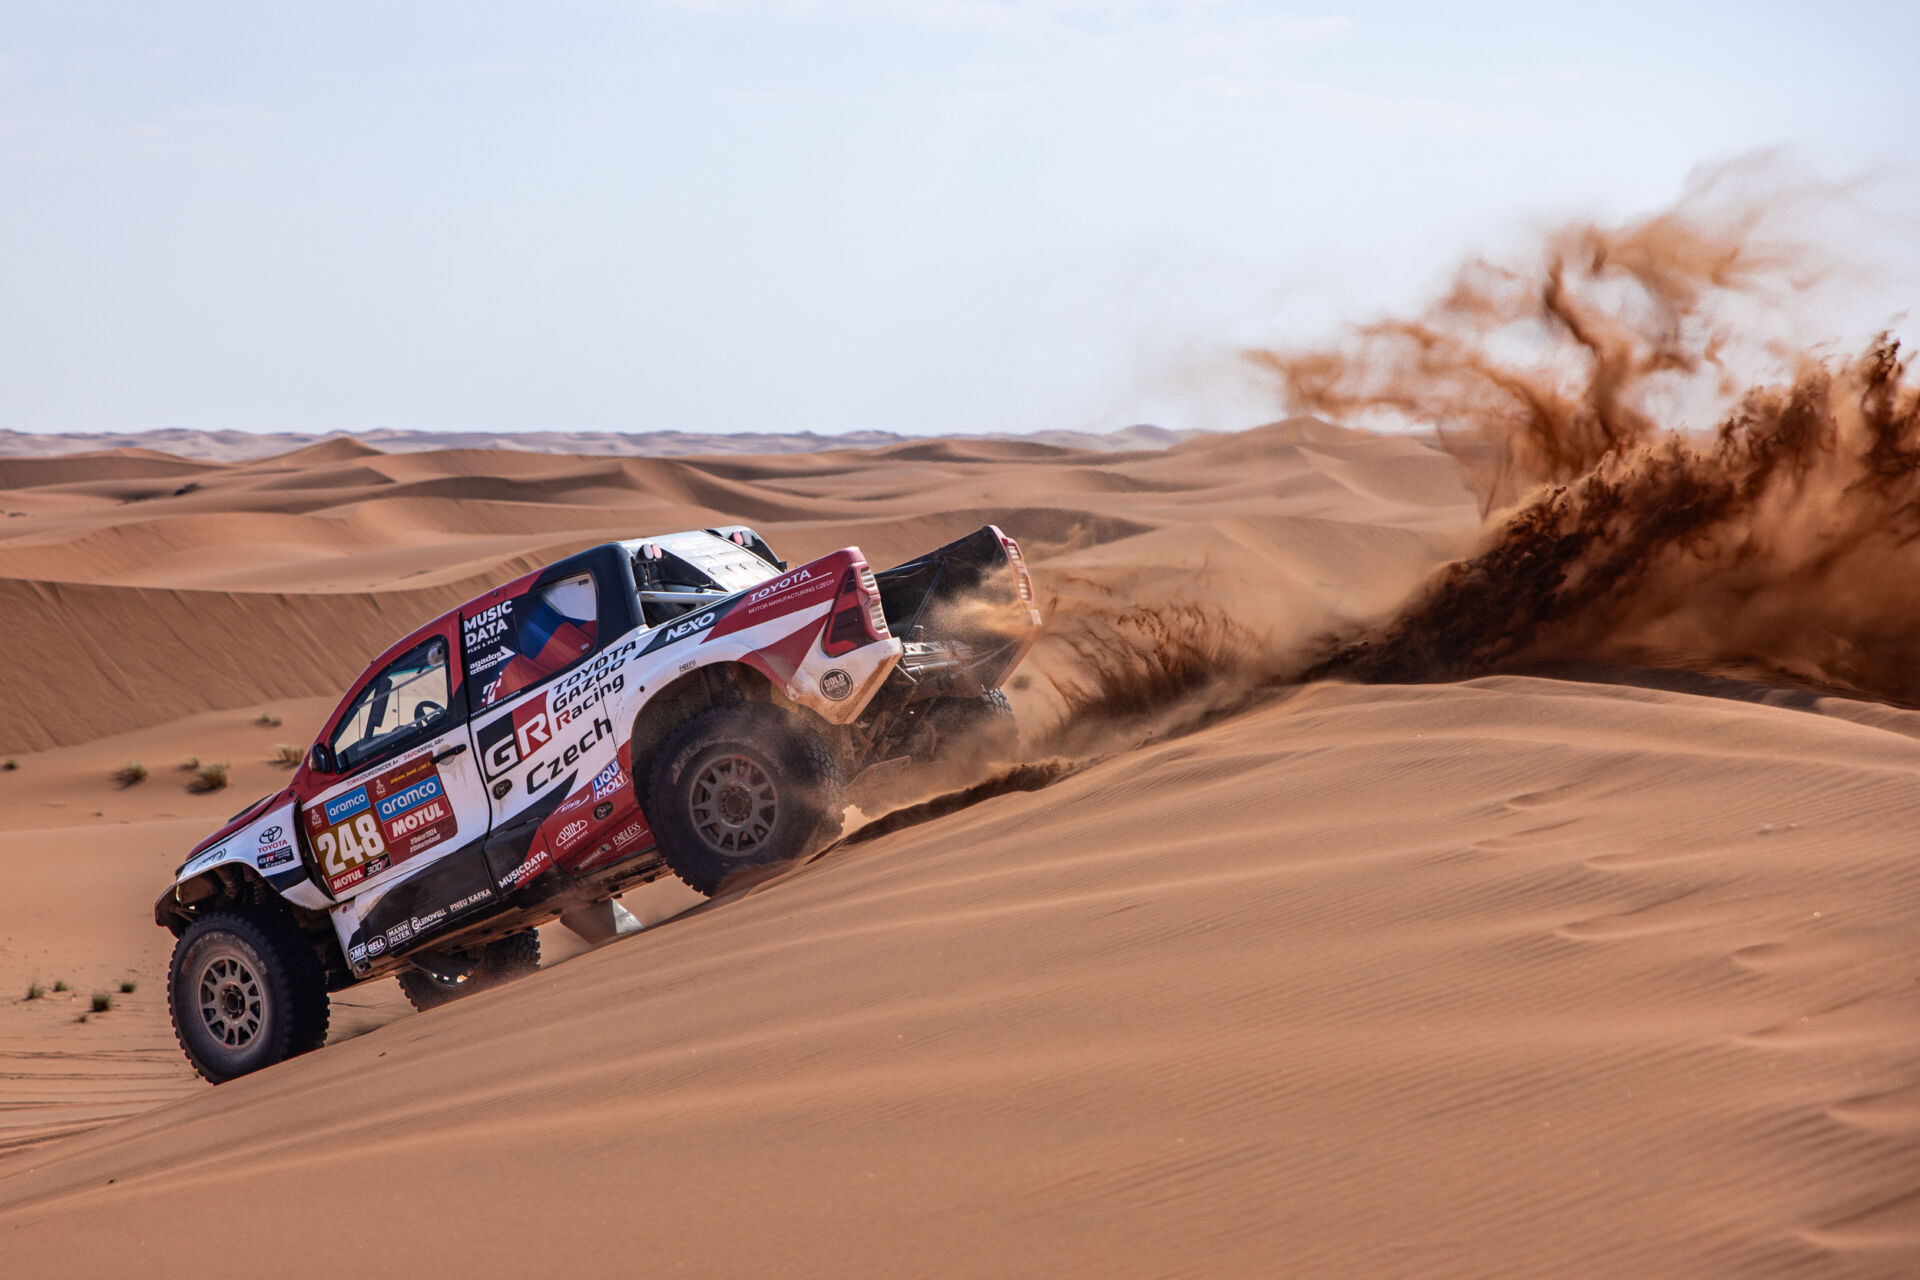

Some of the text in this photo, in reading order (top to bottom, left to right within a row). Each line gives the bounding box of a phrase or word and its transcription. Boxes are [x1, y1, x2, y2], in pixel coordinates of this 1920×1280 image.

[750, 569, 812, 602] TOYOTA
[464, 600, 513, 633] MUSIC
[665, 612, 716, 642] NEXO
[465, 618, 509, 648] DATA
[469, 650, 502, 670] agados
[553, 640, 637, 694] TOYOTA
[553, 658, 626, 713] GAZOO
[823, 673, 845, 687] GOLD
[555, 673, 625, 731] Racing
[526, 717, 613, 795] Czech
[594, 759, 620, 790] LIQUI
[597, 772, 625, 800] MOLY
[329, 793, 366, 816] aramco
[382, 782, 437, 815] aramco
[391, 802, 444, 838] MOTUL
[612, 823, 641, 847] ENDLESS
[257, 839, 288, 854] TOYOTA
[316, 813, 385, 877] 248
[333, 869, 363, 890] MOTUL
[498, 850, 548, 889] MUSICDATA
[449, 888, 492, 912] PNEU KAFKA
[367, 938, 385, 954] BELL
[387, 924, 409, 938] MANN
[389, 930, 411, 945] FILTER
[349, 944, 367, 961] OMP
